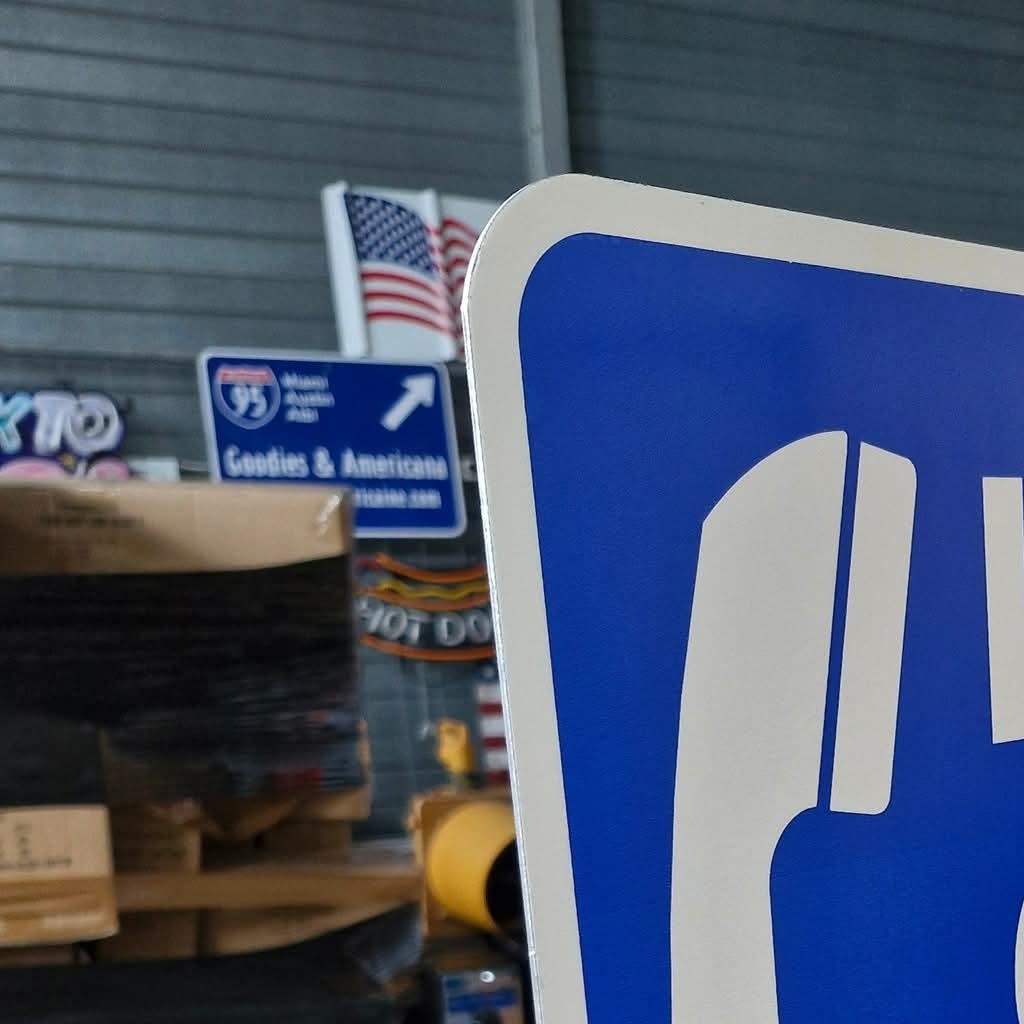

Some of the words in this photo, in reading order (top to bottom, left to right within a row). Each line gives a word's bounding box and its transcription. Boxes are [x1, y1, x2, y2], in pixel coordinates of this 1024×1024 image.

[228, 384, 268, 419] 95
[223, 445, 309, 478] Goodies
[313, 446, 336, 479] &
[342, 447, 449, 480] Americana
[356, 596, 431, 645] HOT
[434, 608, 492, 647] DO
